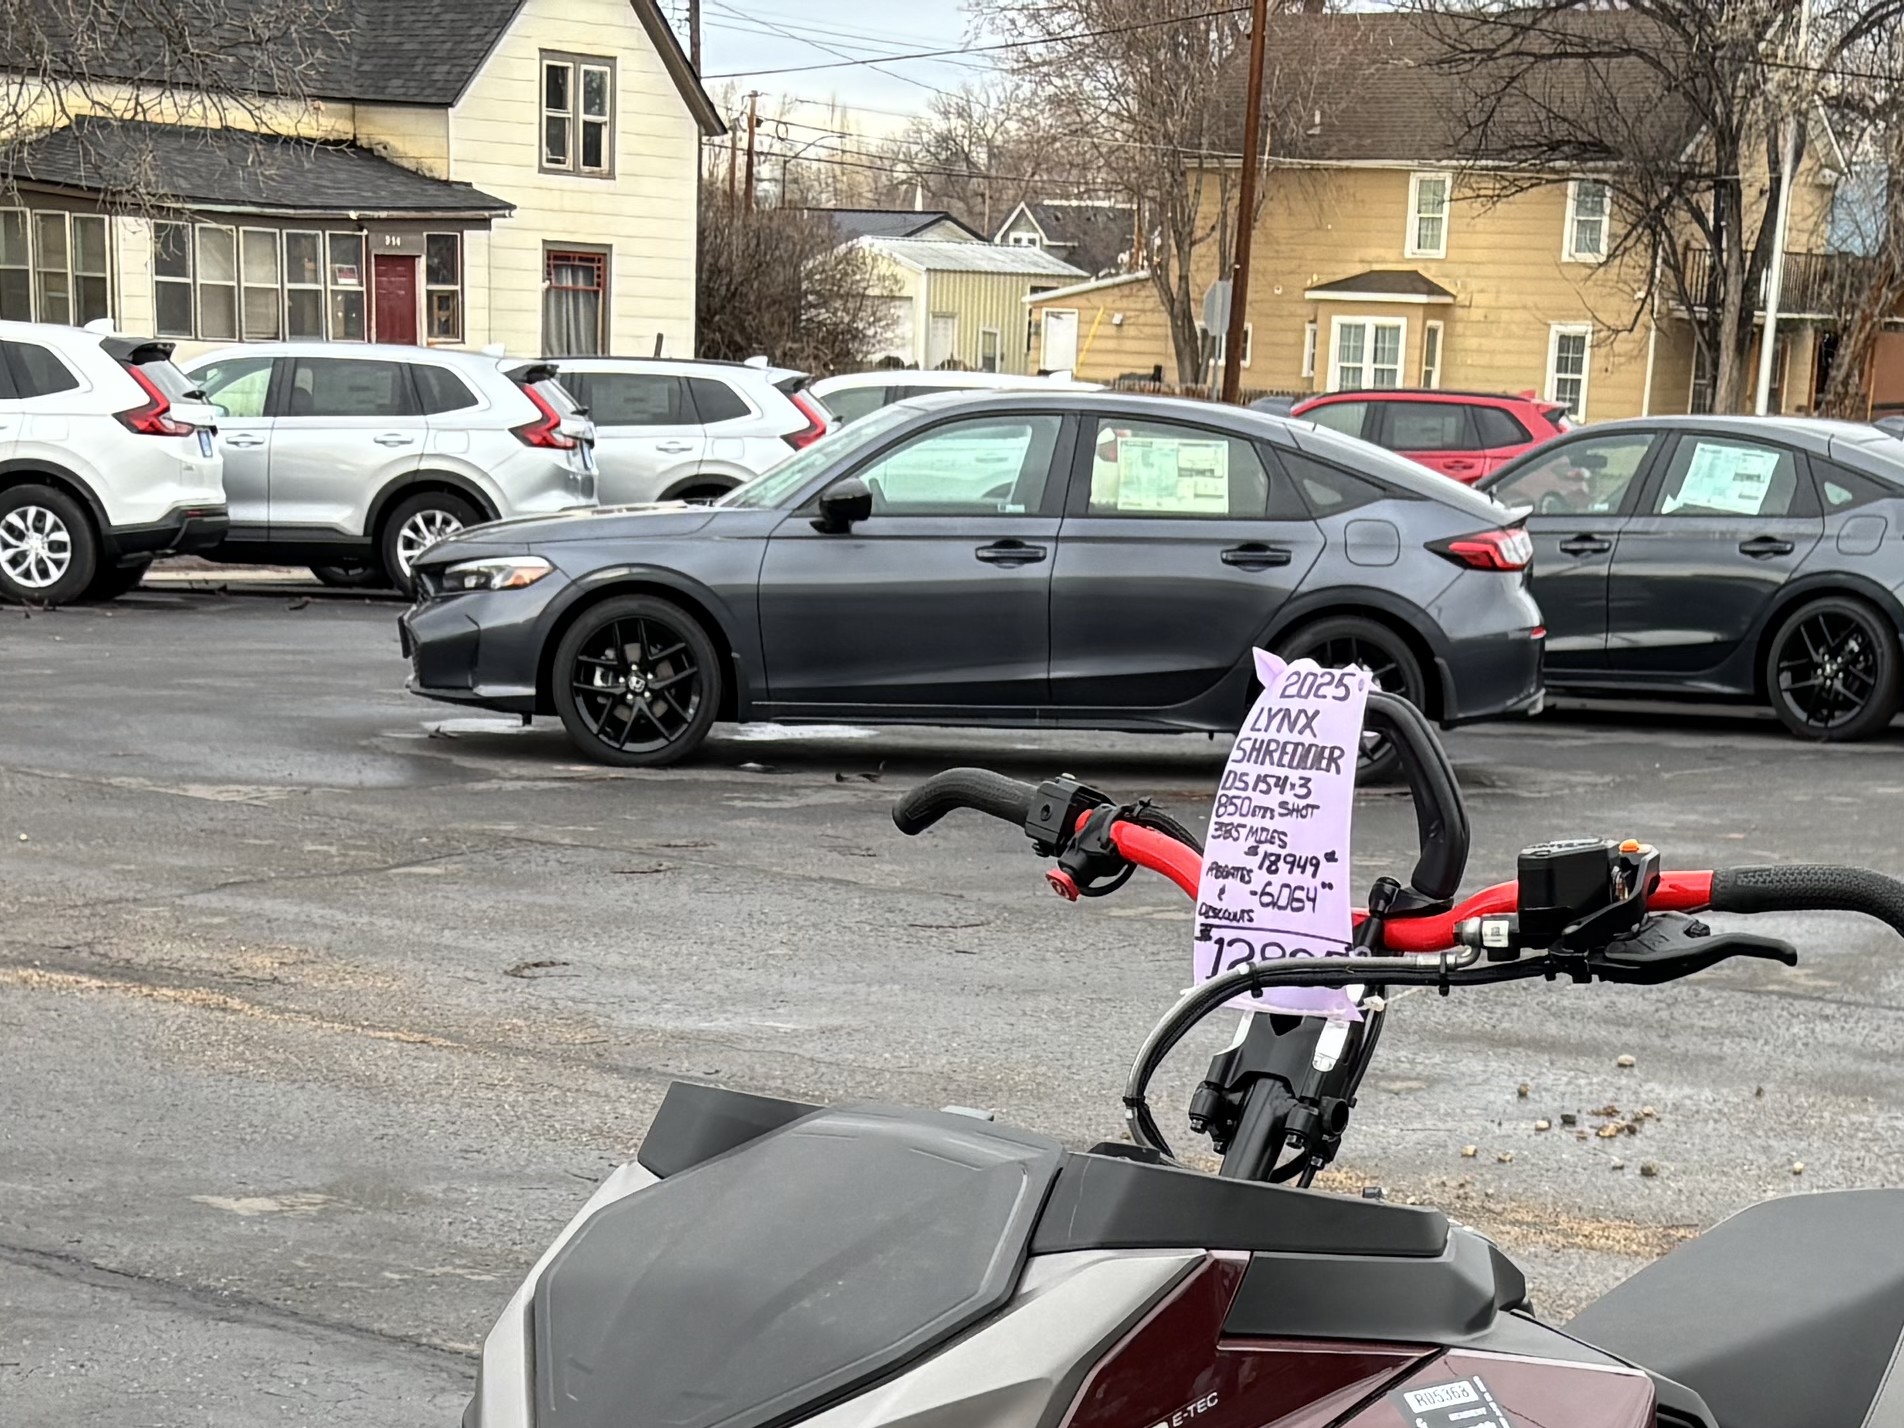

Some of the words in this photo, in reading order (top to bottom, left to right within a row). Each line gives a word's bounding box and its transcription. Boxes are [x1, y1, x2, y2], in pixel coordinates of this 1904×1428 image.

[1280, 671, 1356, 702] 2025
[1250, 707, 1320, 738] LYNX
[1231, 737, 1345, 775] SHREDDER
[1278, 801, 1321, 819] SHOT
[1245, 825, 1288, 849] MILES
[1172, 1392, 1219, 1428] E-TEC
